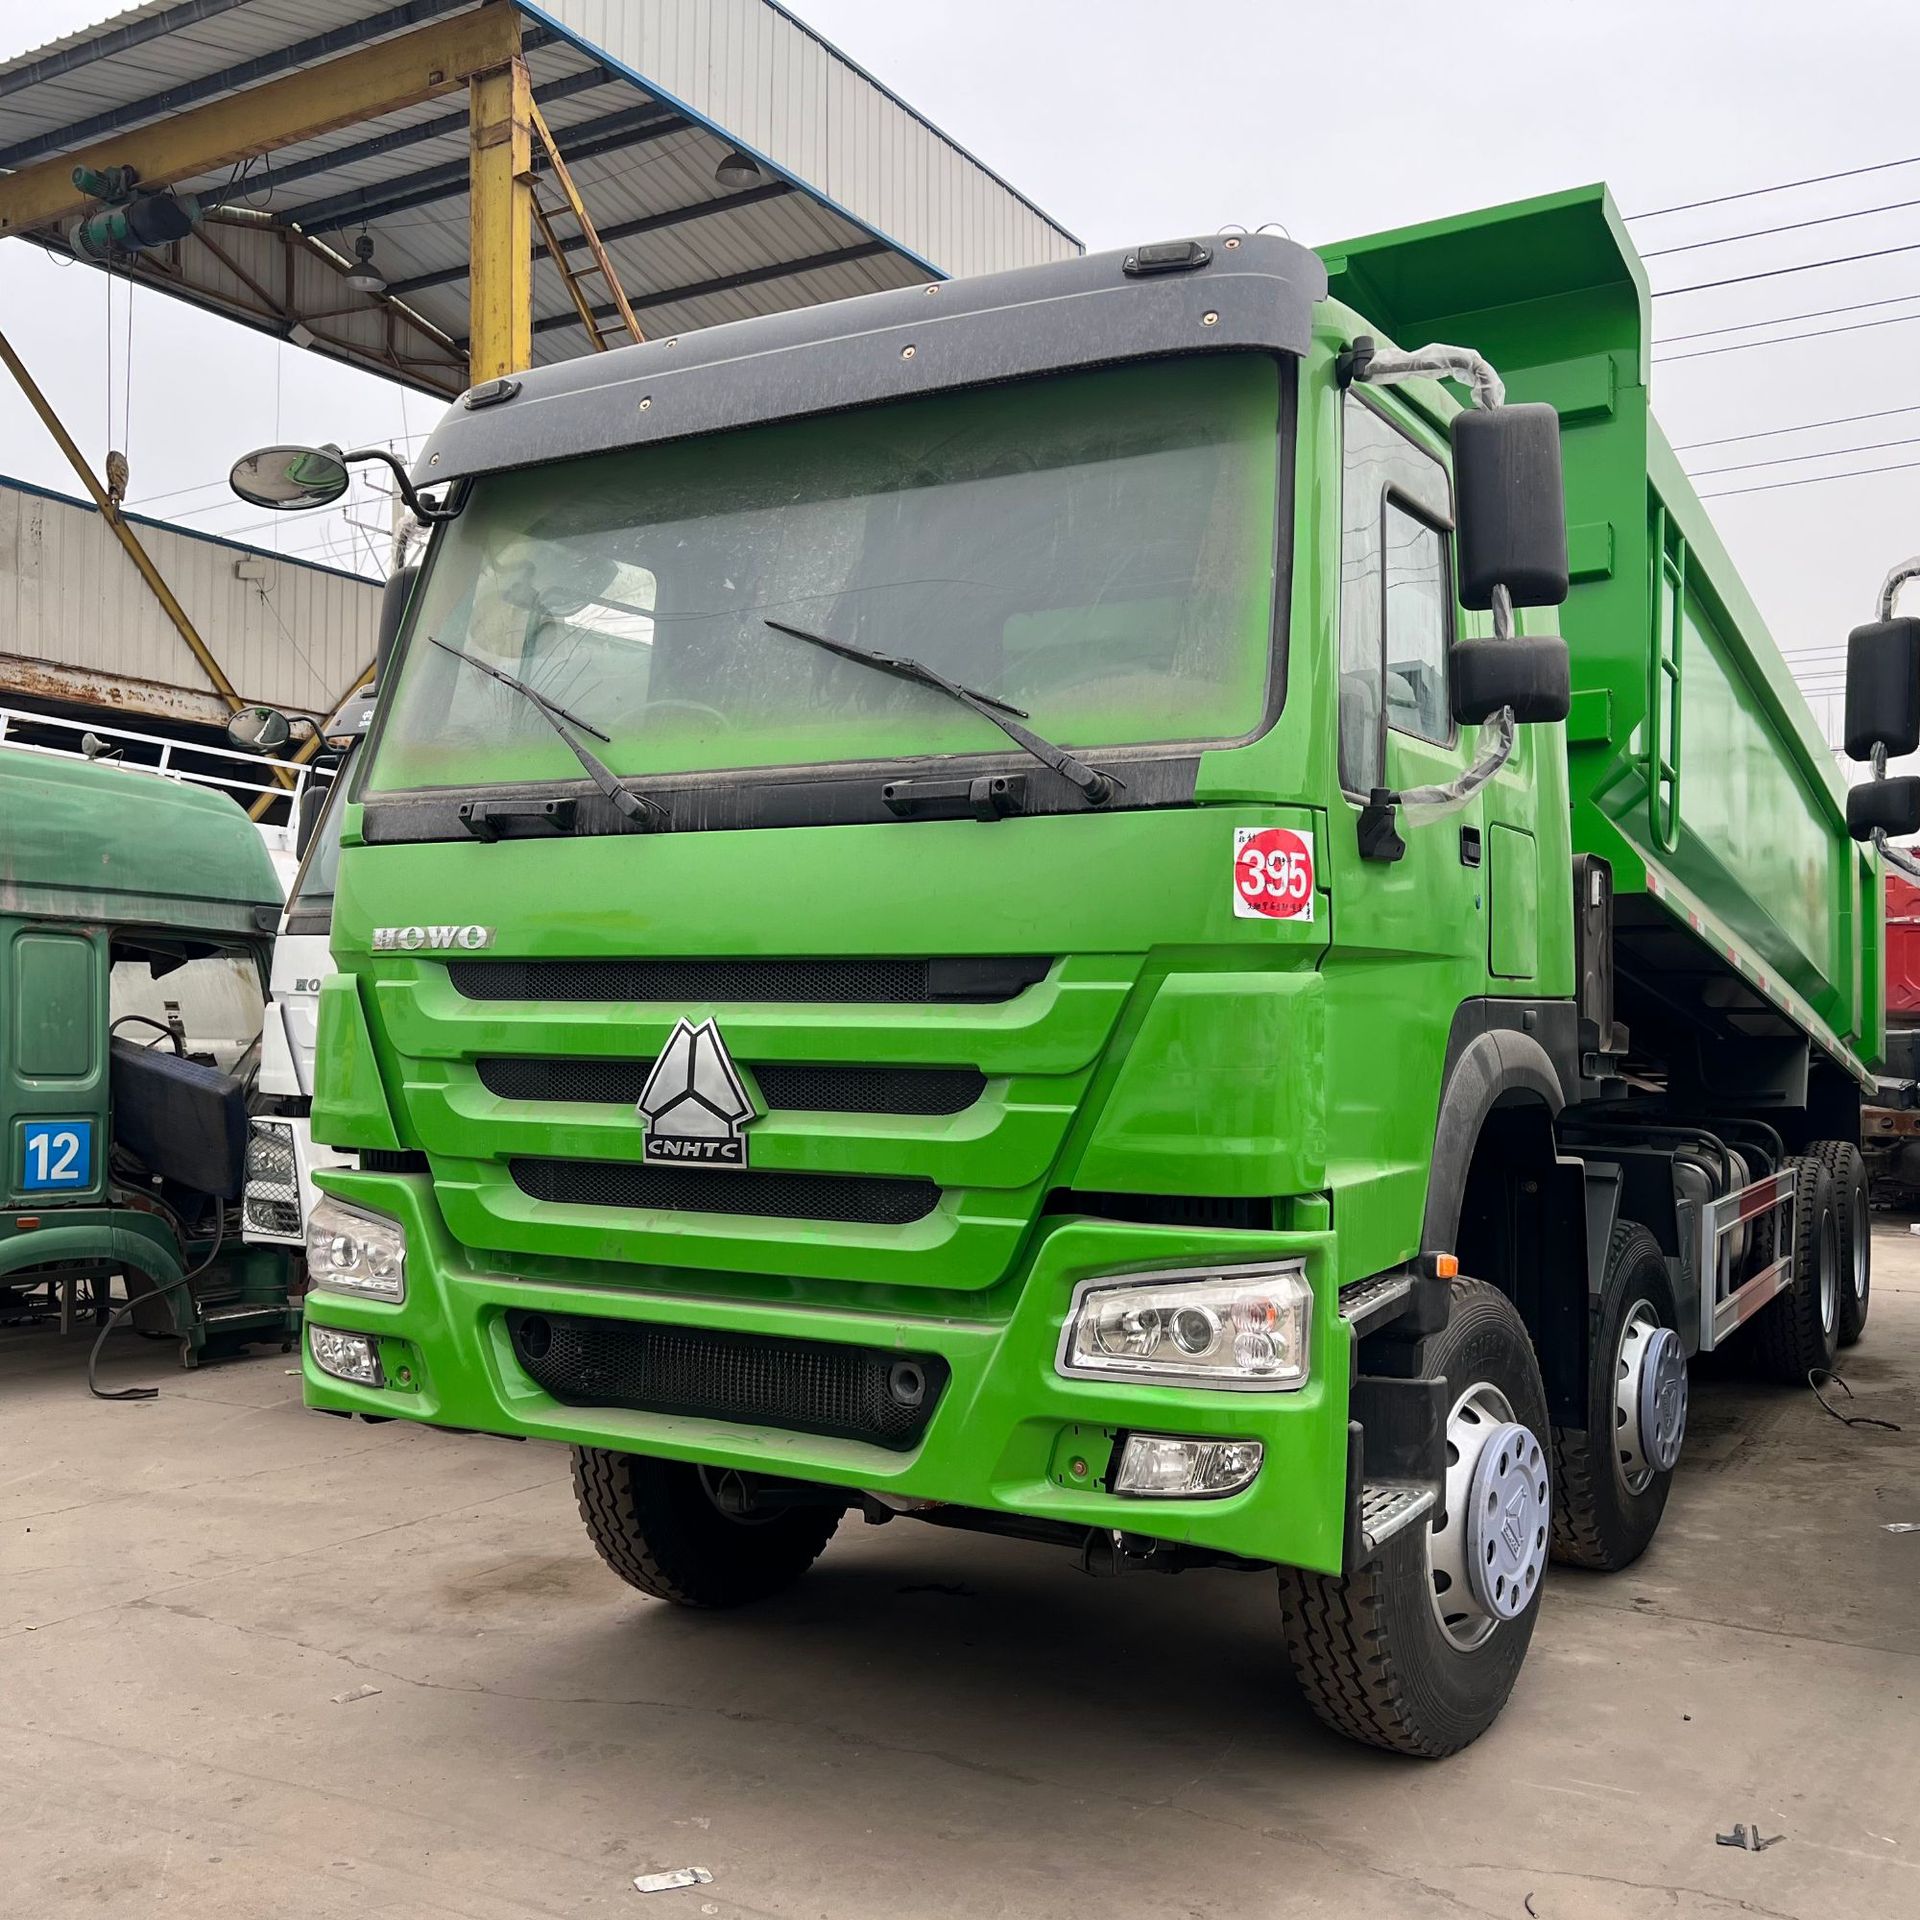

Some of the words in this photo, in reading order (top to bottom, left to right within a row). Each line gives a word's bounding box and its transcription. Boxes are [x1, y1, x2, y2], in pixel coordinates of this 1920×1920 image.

[1240, 848, 1307, 899] 395
[372, 925, 487, 950] HOWO
[29, 1132, 80, 1181] 12
[648, 1139, 739, 1158] CNHTC
